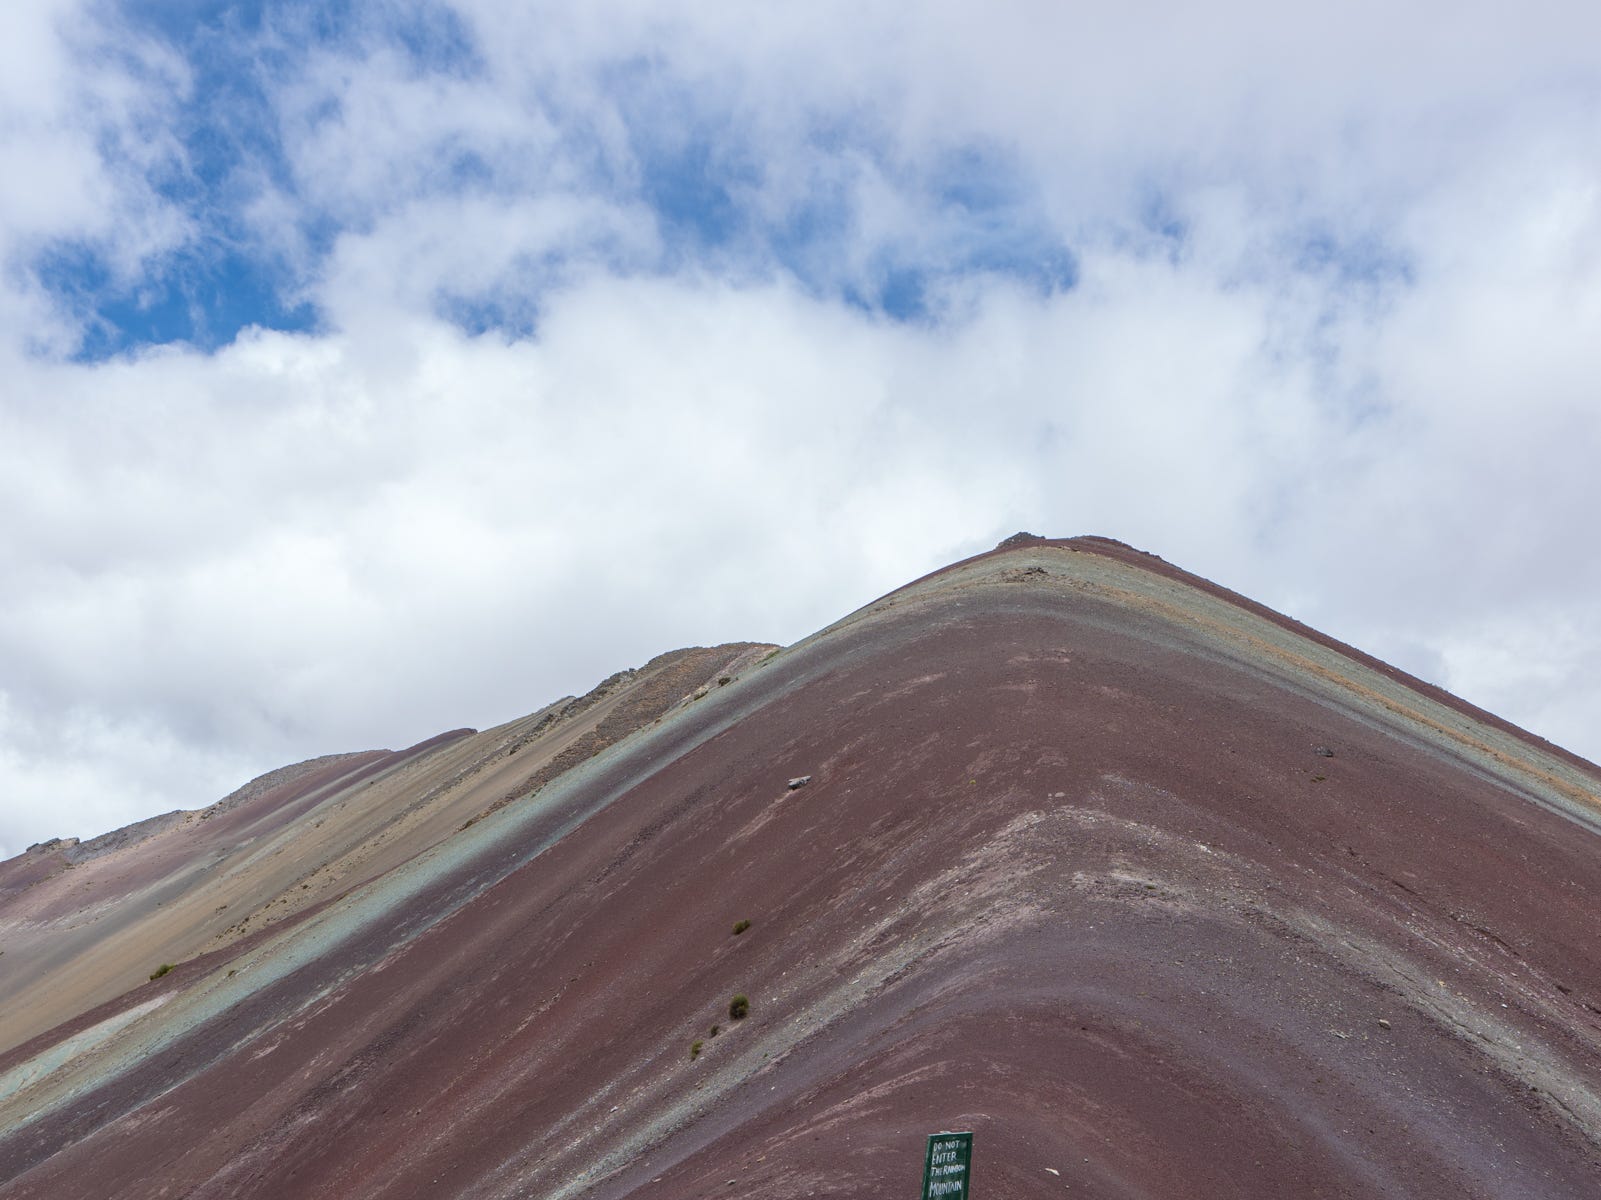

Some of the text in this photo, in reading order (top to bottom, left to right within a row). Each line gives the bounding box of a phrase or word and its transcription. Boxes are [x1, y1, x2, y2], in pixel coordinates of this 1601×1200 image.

[933, 1139, 960, 1152] DO NOT
[931, 1151, 957, 1165] ENTER
[931, 1166, 943, 1176] THE
[929, 1180, 962, 1198] MOUNTAIN
